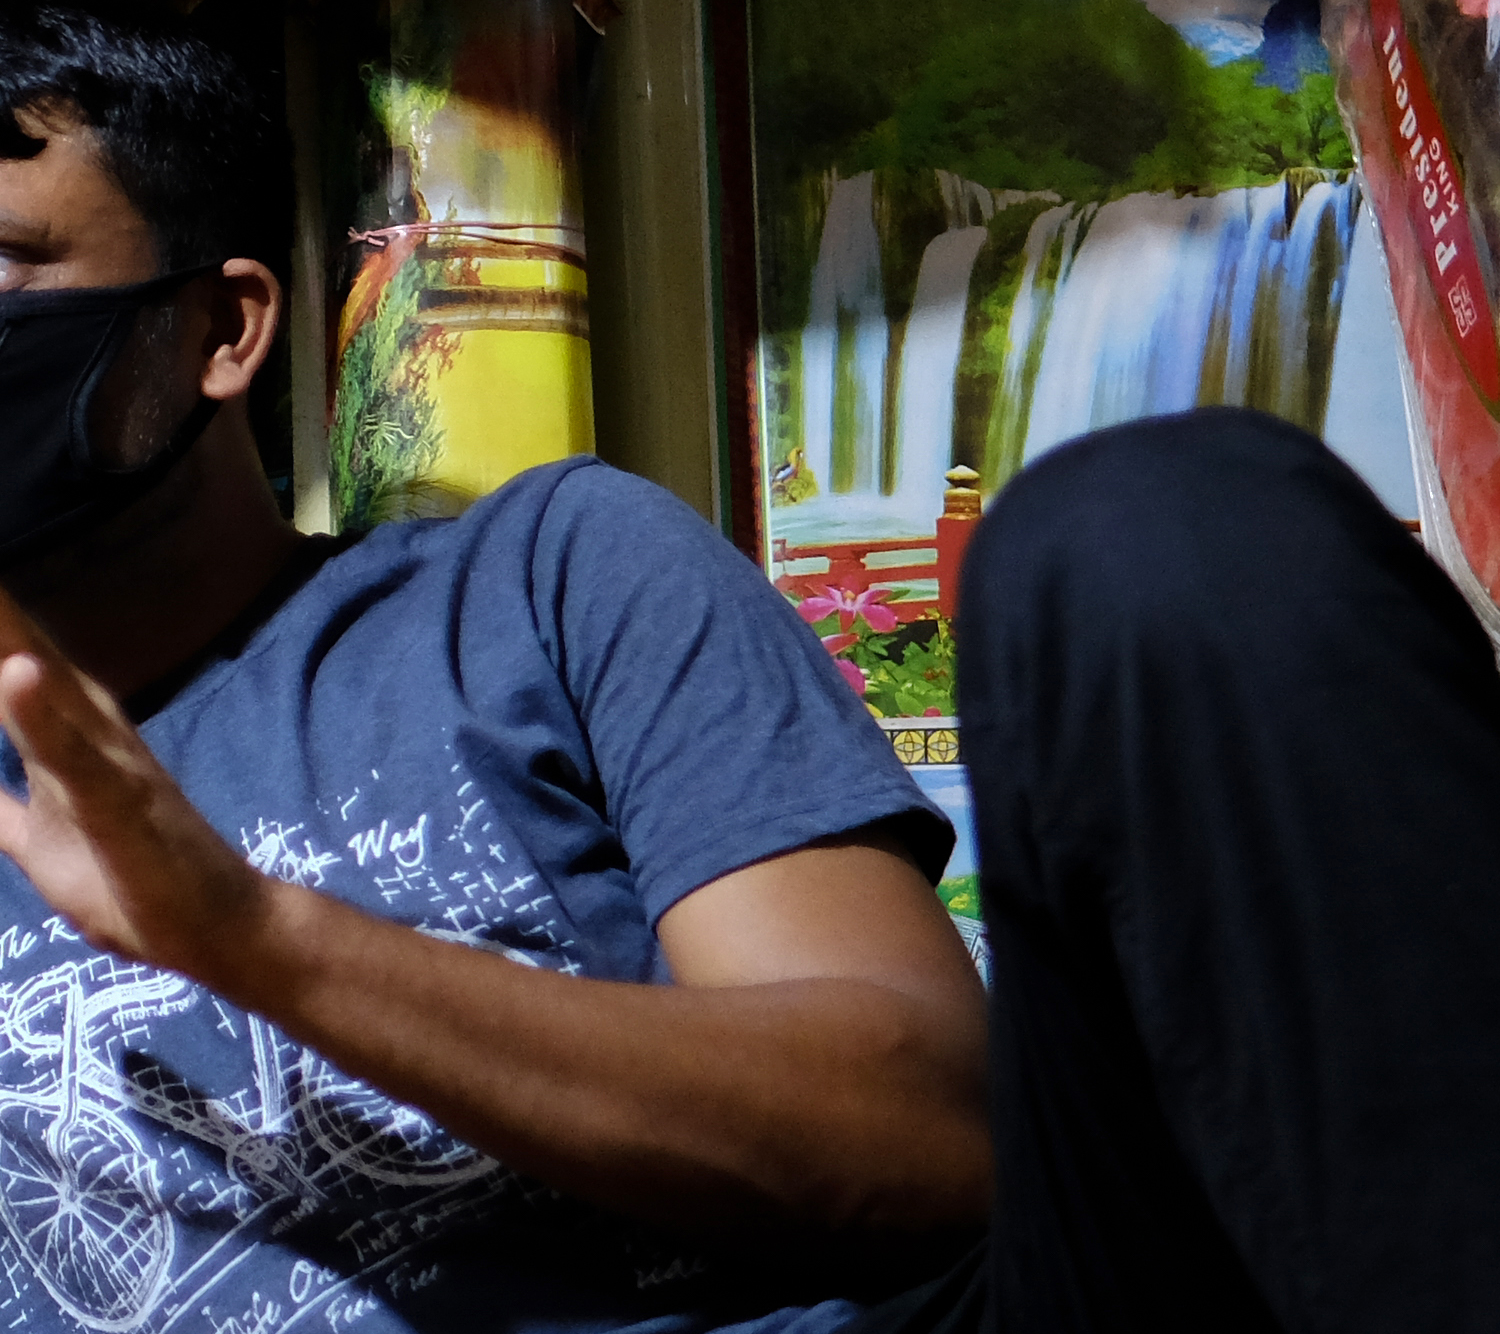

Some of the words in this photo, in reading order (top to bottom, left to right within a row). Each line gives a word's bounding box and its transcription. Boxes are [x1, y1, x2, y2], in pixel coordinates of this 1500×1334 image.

[1382, 26, 1458, 276] President
[1428, 136, 1460, 217] KING
[347, 813, 428, 871] Way
